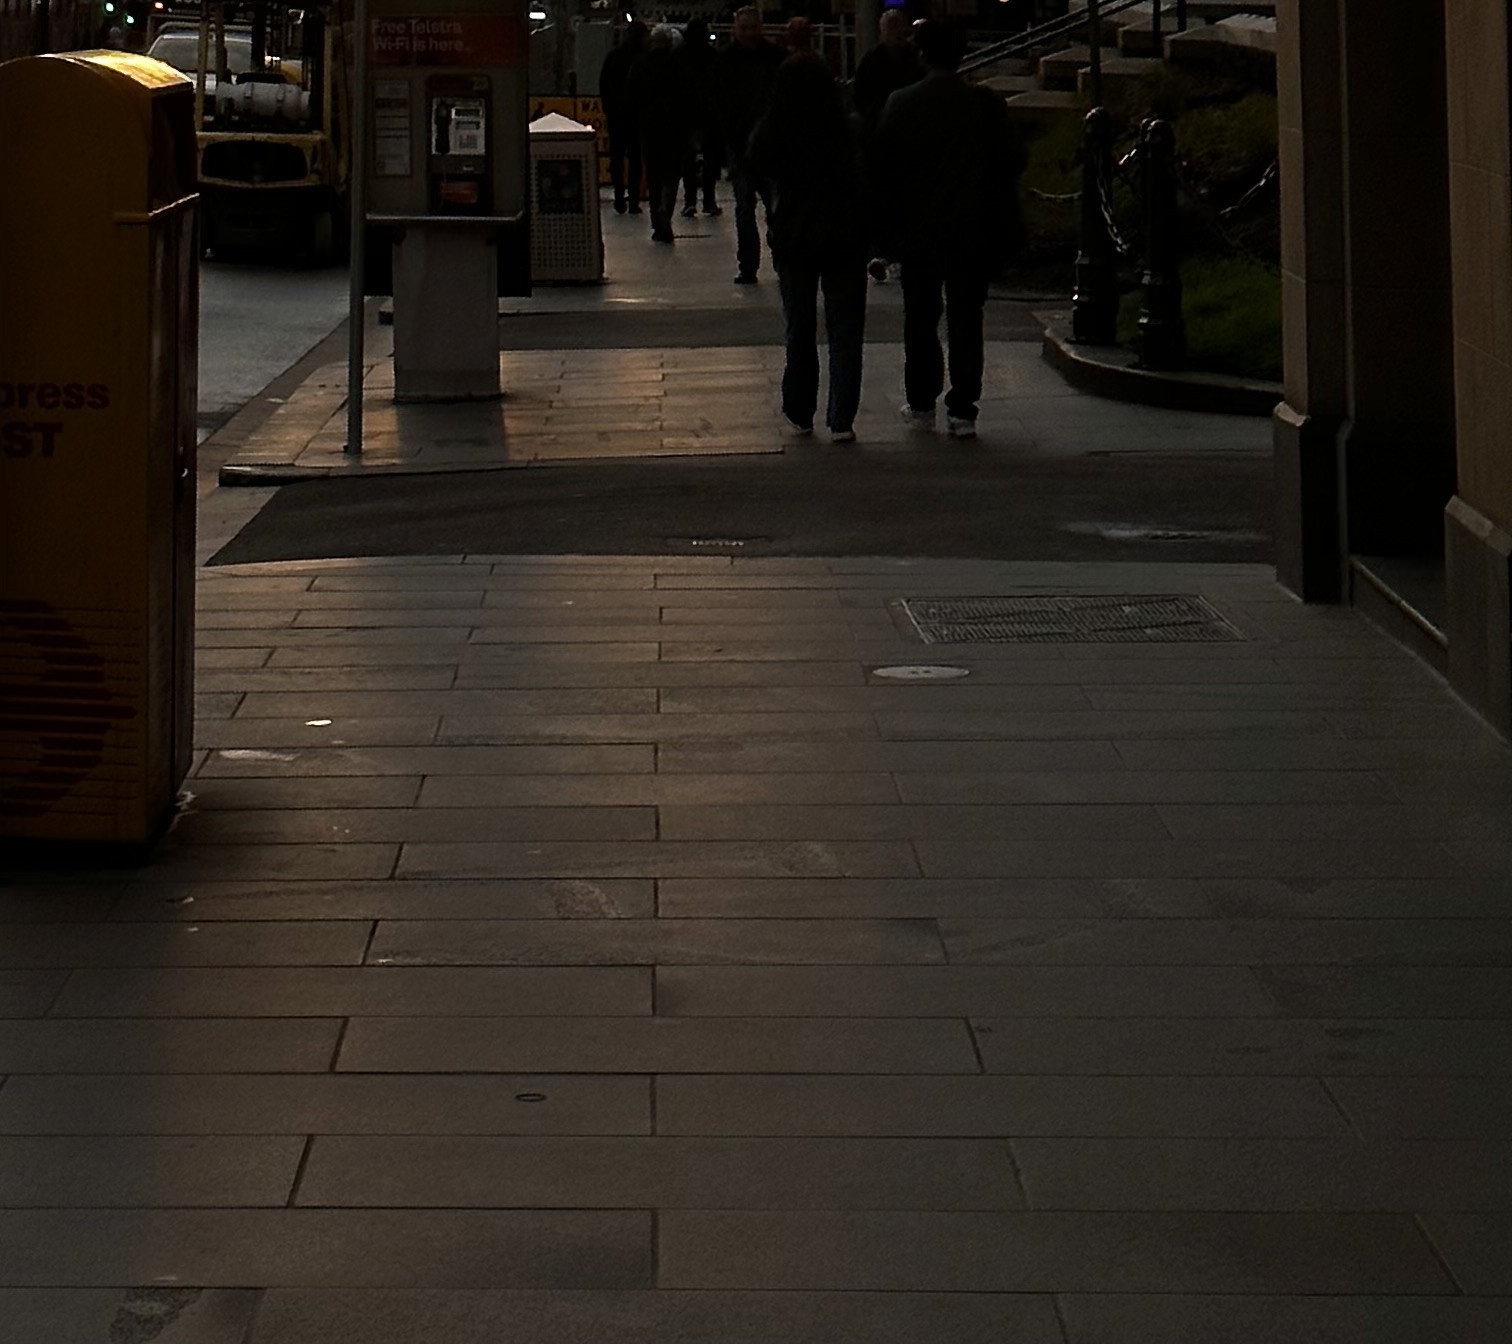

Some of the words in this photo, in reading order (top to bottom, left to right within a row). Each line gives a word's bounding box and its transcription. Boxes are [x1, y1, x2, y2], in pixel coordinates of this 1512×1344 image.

[371, 18, 407, 34] Free
[411, 18, 463, 34] Telstra
[372, 35, 410, 51] Wi-Fi
[412, 36, 426, 51] is
[428, 36, 469, 51] here.
